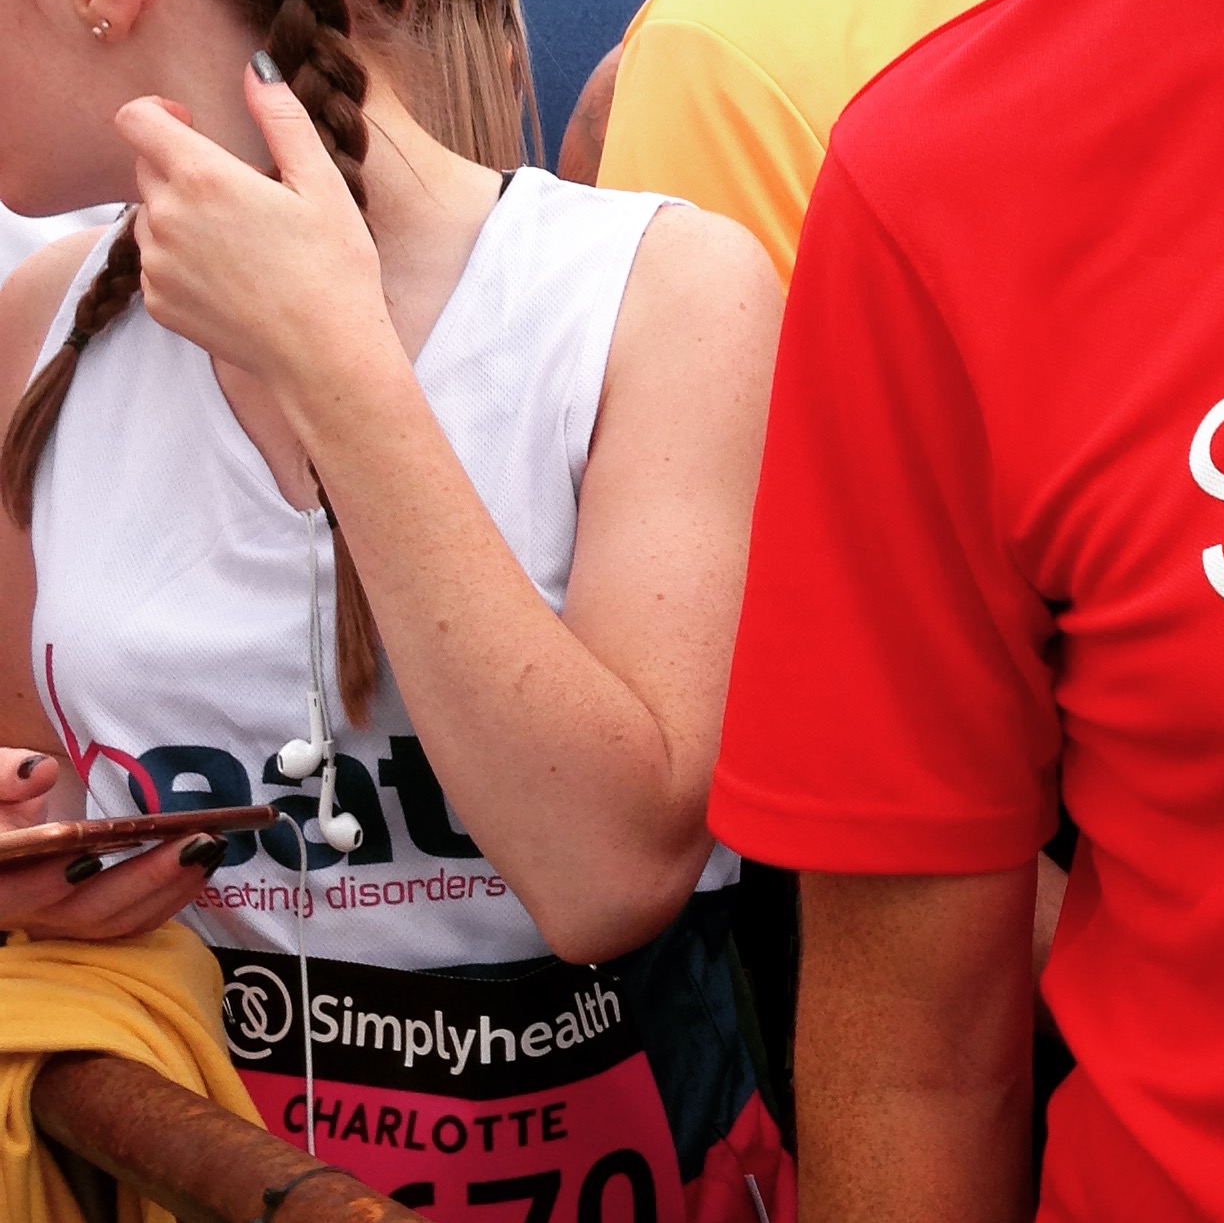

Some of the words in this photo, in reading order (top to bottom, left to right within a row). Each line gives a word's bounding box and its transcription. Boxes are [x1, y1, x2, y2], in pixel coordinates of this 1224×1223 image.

[325, 867, 507, 910] disorders
[311, 982, 621, 1076] Simplyhealth
[284, 1094, 568, 1154] CHARLOTTE
